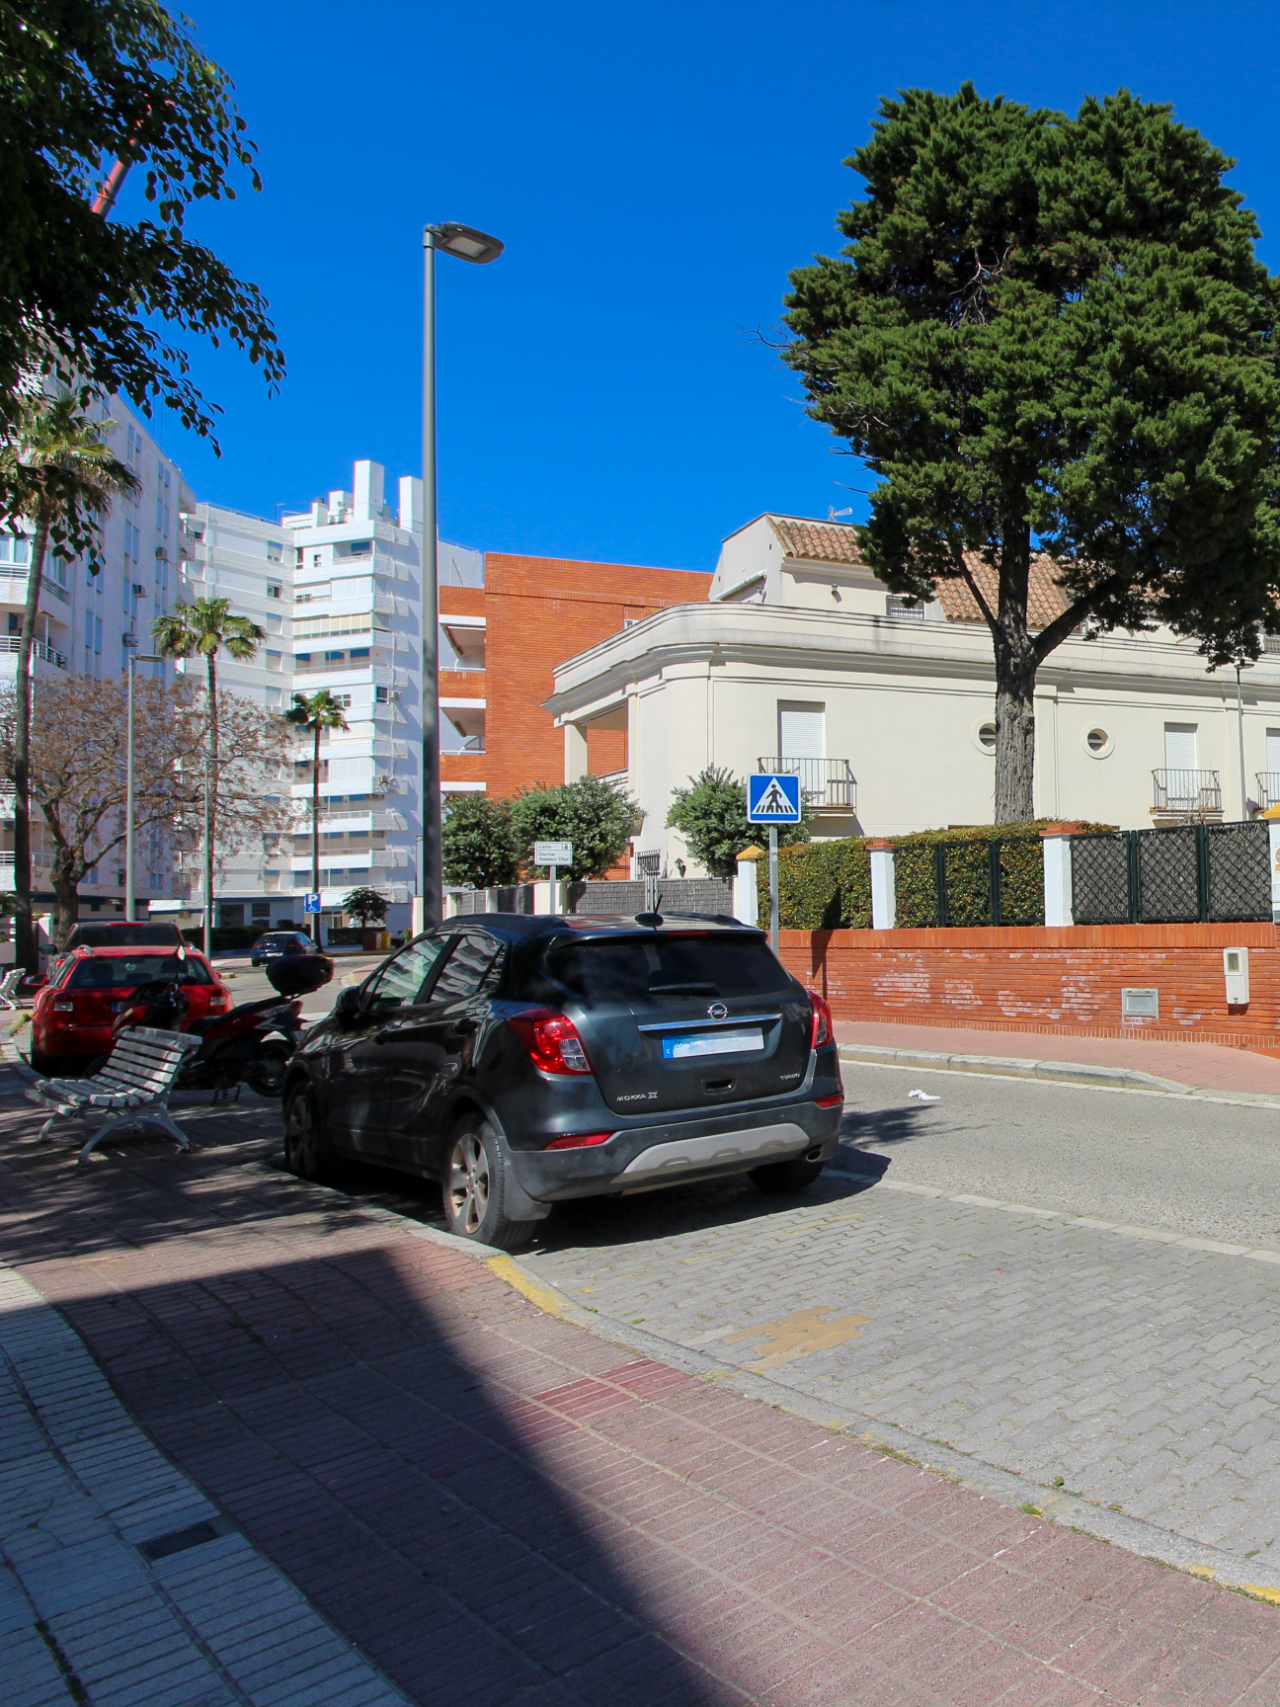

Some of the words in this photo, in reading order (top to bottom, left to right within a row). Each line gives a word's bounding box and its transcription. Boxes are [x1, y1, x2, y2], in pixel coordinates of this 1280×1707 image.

[308, 894, 318, 904] P
[616, 1093, 646, 1101] MOKKA
[648, 1091, 658, 1099] X
